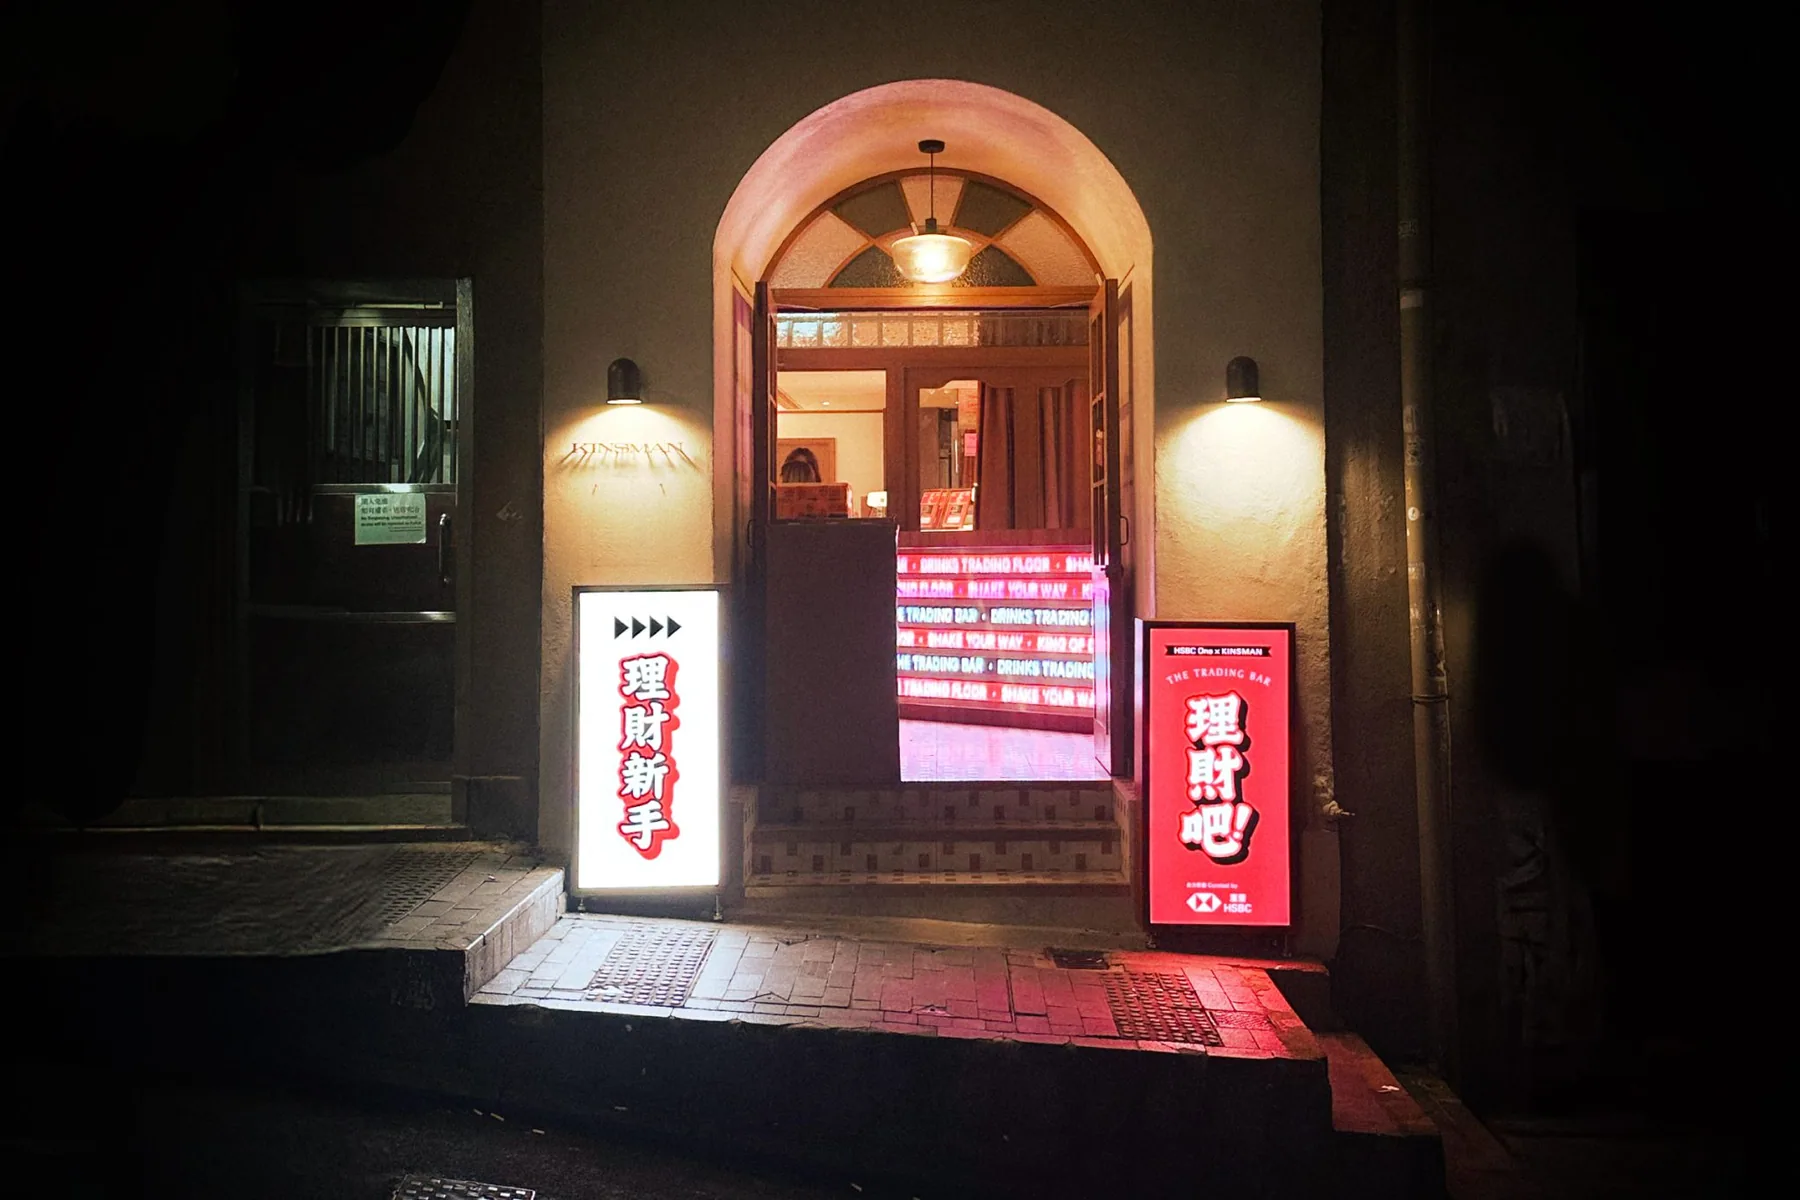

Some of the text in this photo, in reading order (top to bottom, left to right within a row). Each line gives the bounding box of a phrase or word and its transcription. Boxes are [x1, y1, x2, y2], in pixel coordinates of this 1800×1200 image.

[572, 442, 684, 453] KINSMAN
[1040, 583, 1067, 598] WAY
[906, 607, 953, 623] TRADING
[955, 608, 978, 623] BAR
[990, 608, 1033, 625] DRINKS
[1035, 609, 1089, 626] TRADING
[928, 632, 963, 648] SHAKE
[966, 633, 996, 649] YOUR
[997, 634, 1024, 649] WAY
[1037, 637, 1066, 652] KING
[1068, 638, 1085, 653] OF
[1173, 646, 1197, 655] HSBC
[1197, 646, 1214, 655] One
[1221, 647, 1263, 656] KINSMAN
[912, 655, 959, 672] TRADING
[961, 657, 985, 673] BAR
[997, 659, 1039, 676] DRINKS
[1165, 667, 1272, 687] THE TRADING BAR
[951, 682, 987, 700] FLOOR
[1042, 687, 1075, 706] YOUR
[618, 652, 674, 852] 理財新手
[1223, 903, 1252, 913] HSBC
